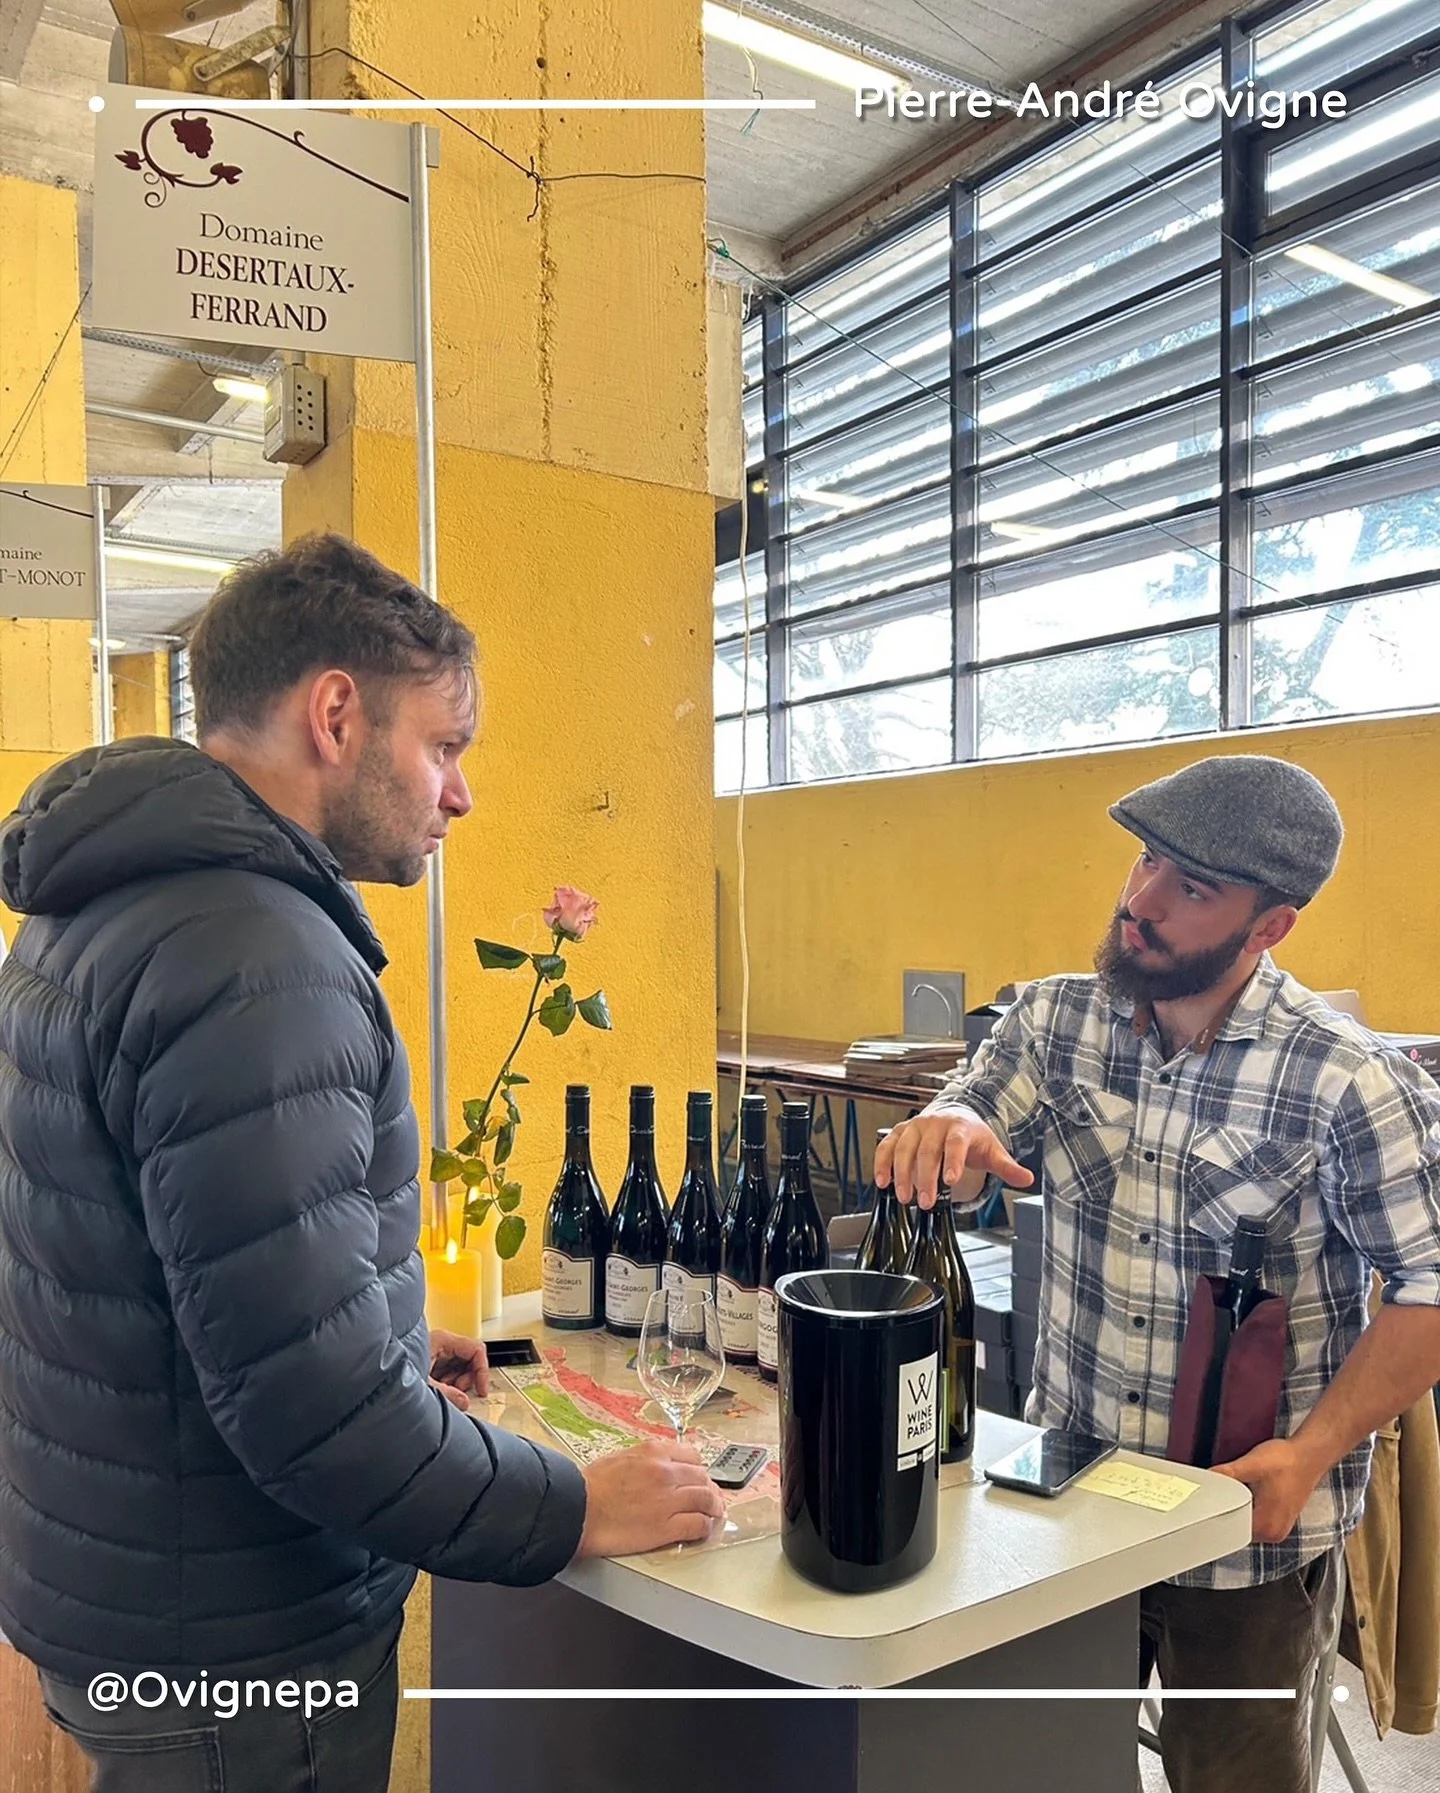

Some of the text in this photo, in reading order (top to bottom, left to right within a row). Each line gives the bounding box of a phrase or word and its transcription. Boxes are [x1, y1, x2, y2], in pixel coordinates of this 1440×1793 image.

[199, 212, 324, 251] Domaine
[176, 248, 355, 294] DESERTAUX-
[190, 292, 328, 333] FERRAND
[907, 1404, 932, 1425] WINE
[907, 1419, 932, 1440] PARIS
